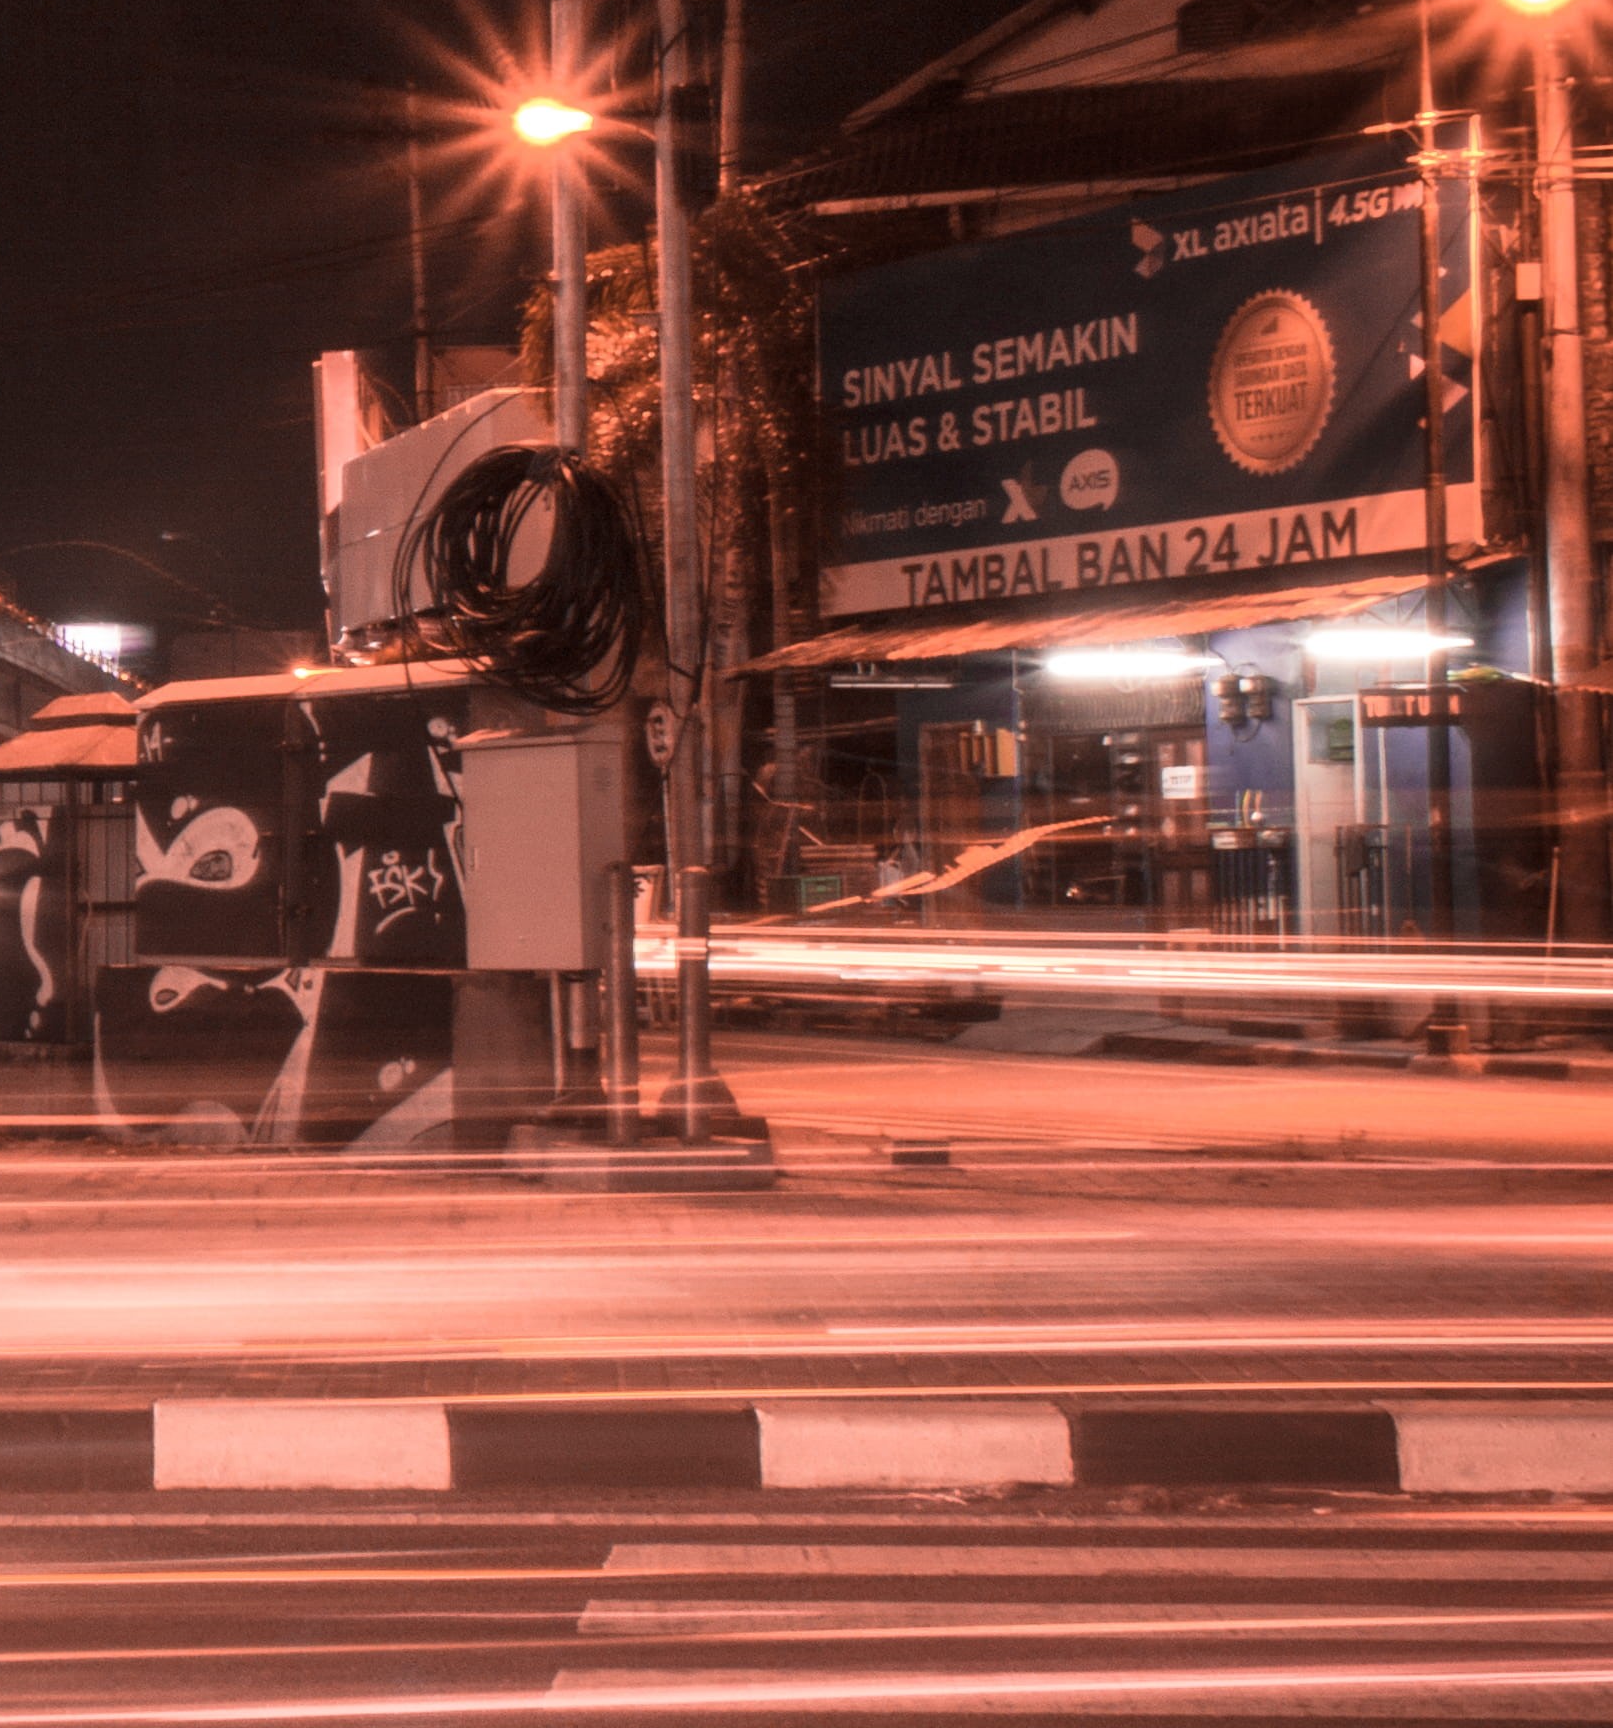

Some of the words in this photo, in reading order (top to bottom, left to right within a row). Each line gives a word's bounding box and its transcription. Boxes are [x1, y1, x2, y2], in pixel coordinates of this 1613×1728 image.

[1172, 228, 1209, 261] XL
[1213, 199, 1309, 252] axiata
[1328, 187, 1389, 227] 4.5G
[842, 351, 962, 408] SINYAL
[972, 312, 1138, 384] SEMAKIN
[843, 417, 928, 466] LUAS
[938, 412, 962, 452] &
[972, 388, 1098, 447] STABIL
[1234, 382, 1308, 421] TERKUAT
[843, 505, 909, 537] Nikmati
[914, 497, 986, 528] dengan
[1066, 469, 1112, 492] AXIS
[901, 547, 1063, 607] TAMBAL
[1076, 532, 1168, 587] BAN
[1184, 522, 1240, 573] 24
[1257, 507, 1357, 567] JAM
